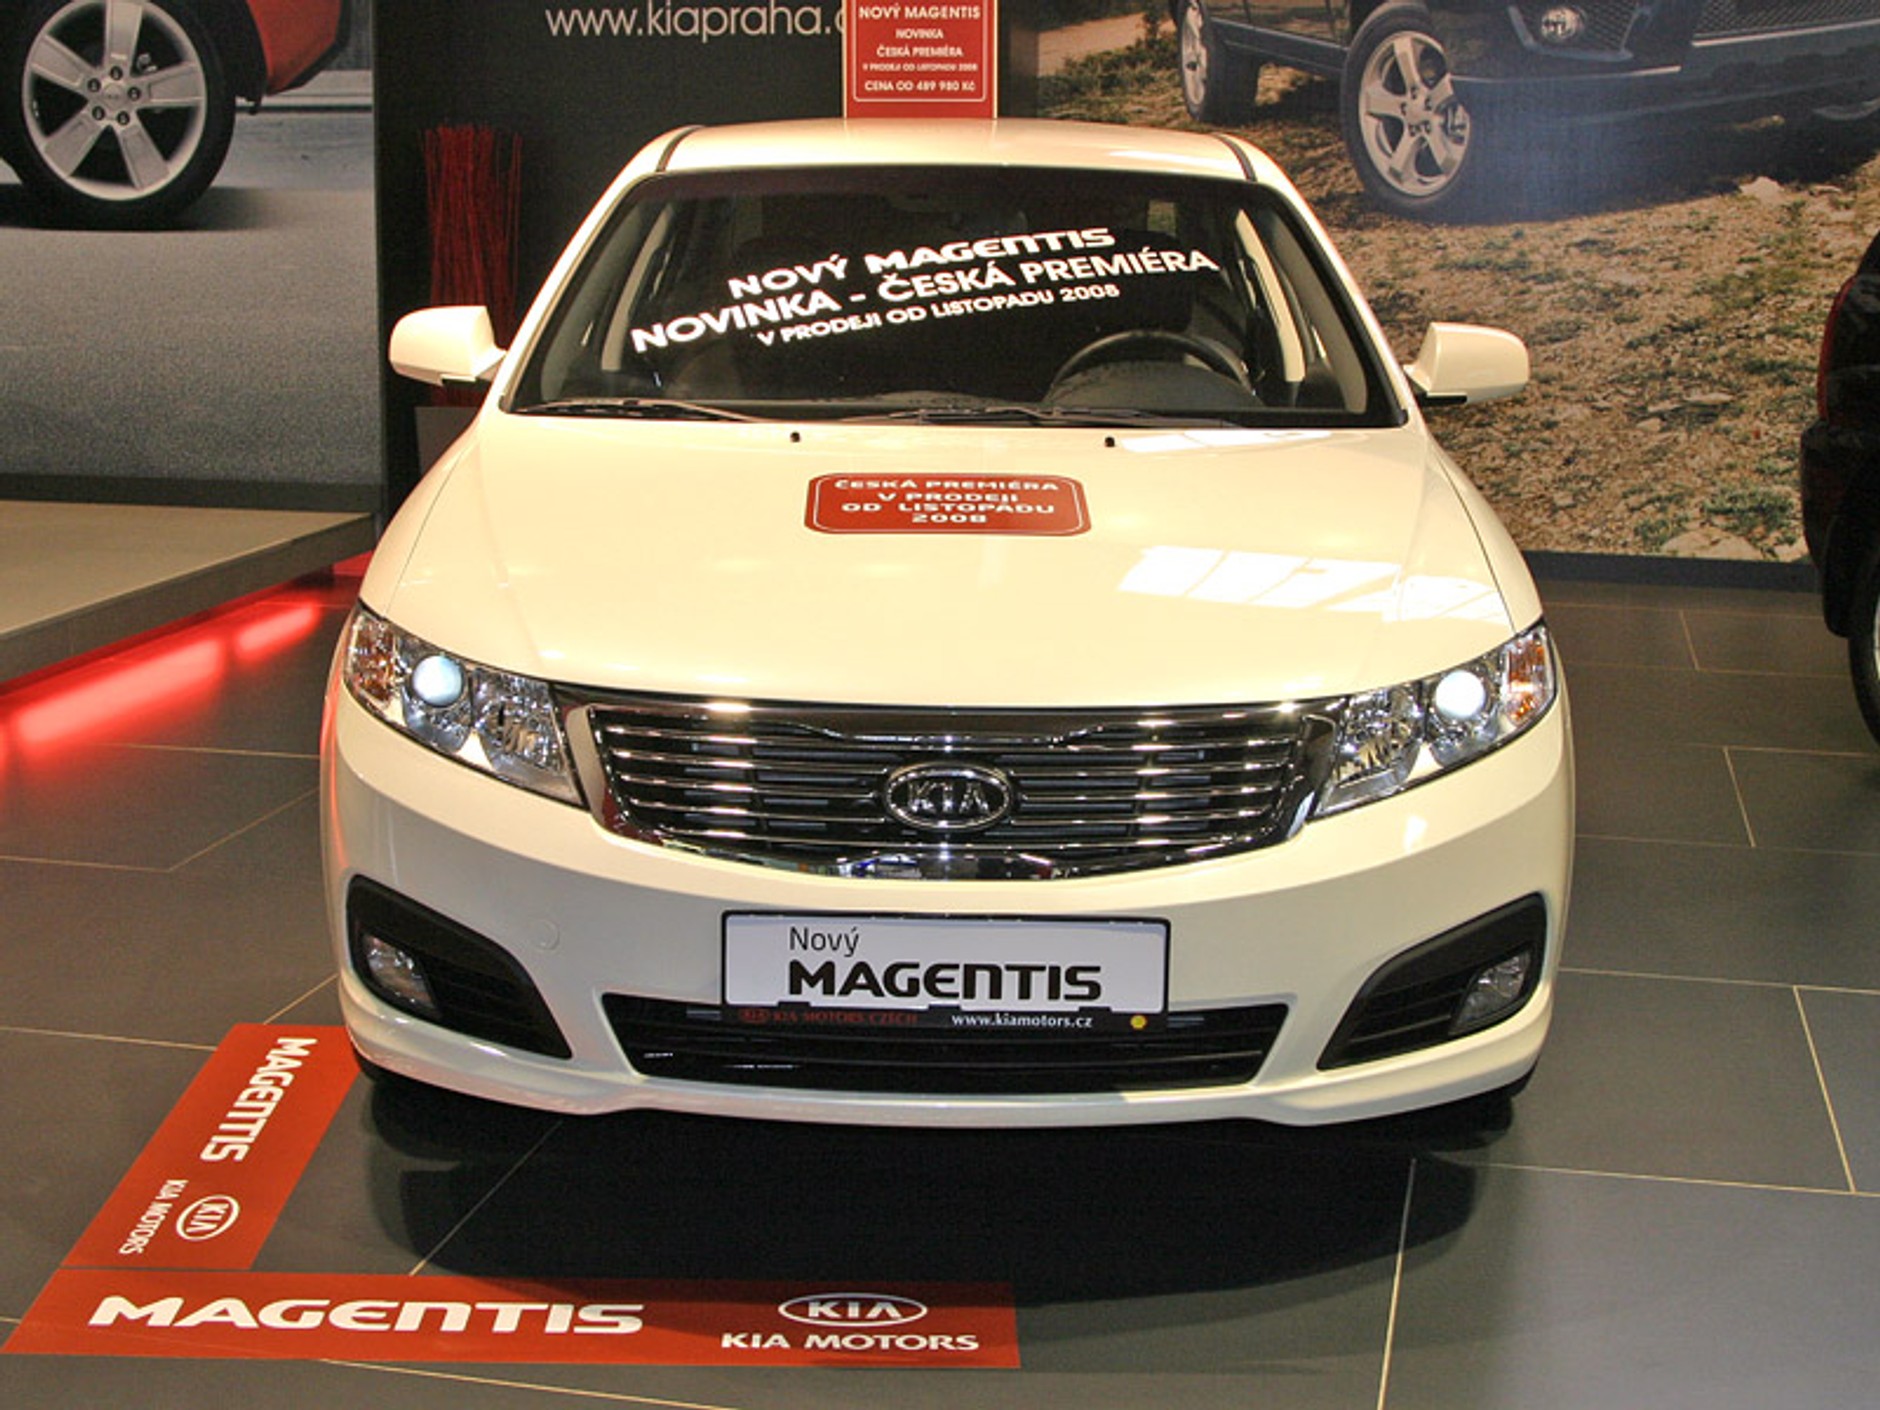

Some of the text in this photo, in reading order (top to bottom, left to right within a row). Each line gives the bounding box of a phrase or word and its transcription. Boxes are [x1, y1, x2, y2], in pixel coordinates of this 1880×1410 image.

[859, 3, 981, 19] NOVÝ MAGENTIS
[545, 0, 842, 43] www.kiapraha.
[895, 28, 944, 39] NOVINKA
[876, 44, 964, 57] ČESKÁ PREMIÉRA
[864, 80, 894, 92] CENA
[896, 80, 913, 92] OD
[916, 80, 936, 92] 489
[728, 227, 1116, 299] NOVÝ MAGENTIS
[630, 289, 842, 353] NOVINKA
[877, 260, 1016, 302] ČESKÁ
[1019, 246, 1220, 284] PREMIÉRA
[757, 284, 1120, 347] V PRODEJI OD LISTOPADU 2008
[925, 479, 1059, 491] PREMIÉRA
[877, 492, 1019, 504] V PRODEJI
[841, 502, 1055, 514] OD LISTOPADU
[911, 514, 988, 523] 2008
[908, 781, 990, 814] KIA
[789, 926, 860, 957] Nový
[788, 960, 1102, 1001] MAGENTIS
[951, 1012, 1093, 1029] www.kiamotors.cz
[200, 1038, 317, 1162] MAGENTIS
[119, 1179, 189, 1254] KIA MOTORS
[88, 1296, 645, 1334] MAGENTIS
[807, 1300, 901, 1319] KIA
[721, 1333, 979, 1350] KIA MOTORS
